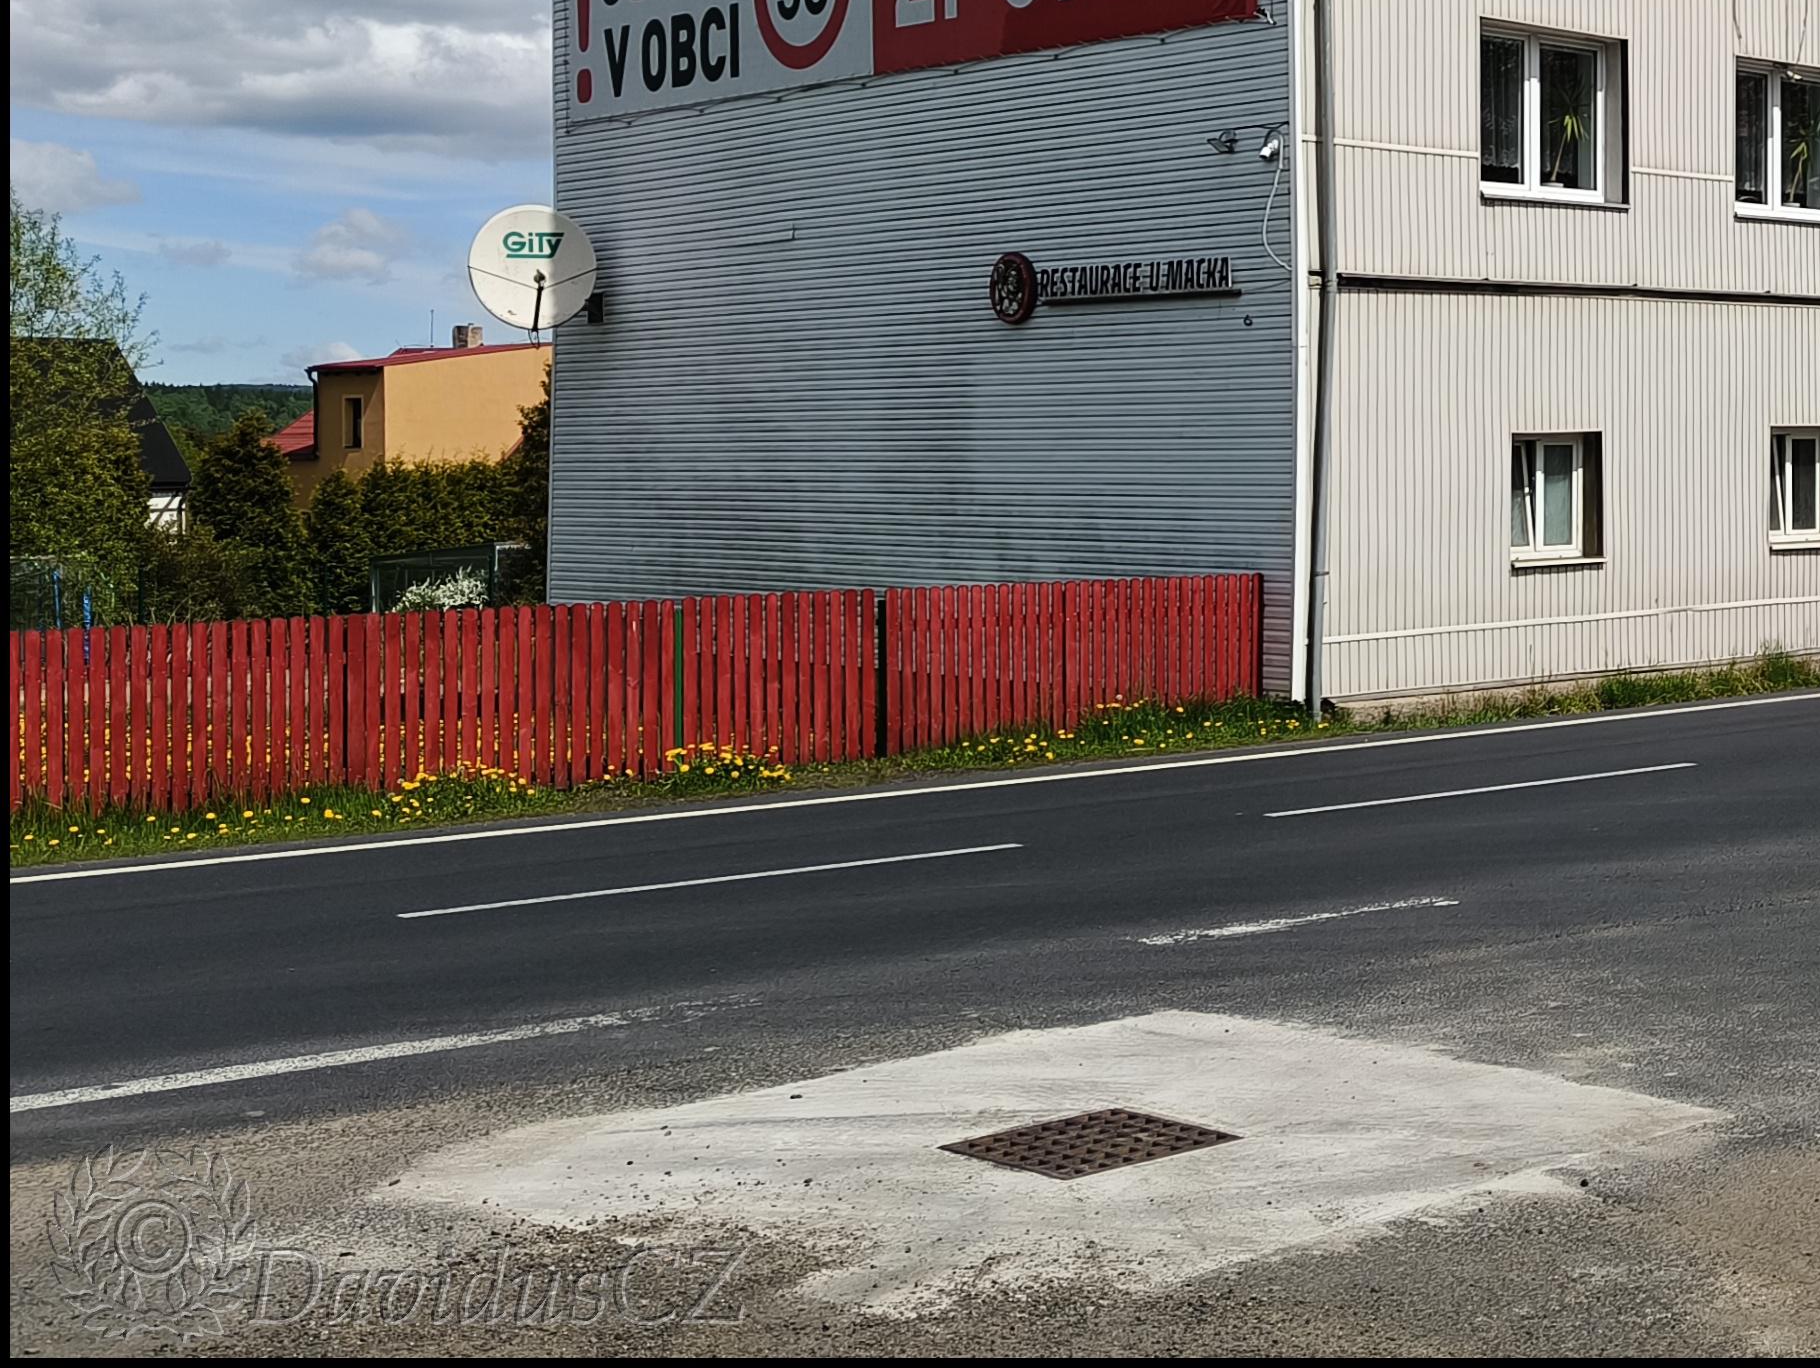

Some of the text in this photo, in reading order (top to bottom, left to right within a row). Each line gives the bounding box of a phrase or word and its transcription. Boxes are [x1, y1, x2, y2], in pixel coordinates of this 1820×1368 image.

[604, 3, 740, 98] V OBCI
[1039, 257, 1232, 298] RESTAURACE U MACKA
